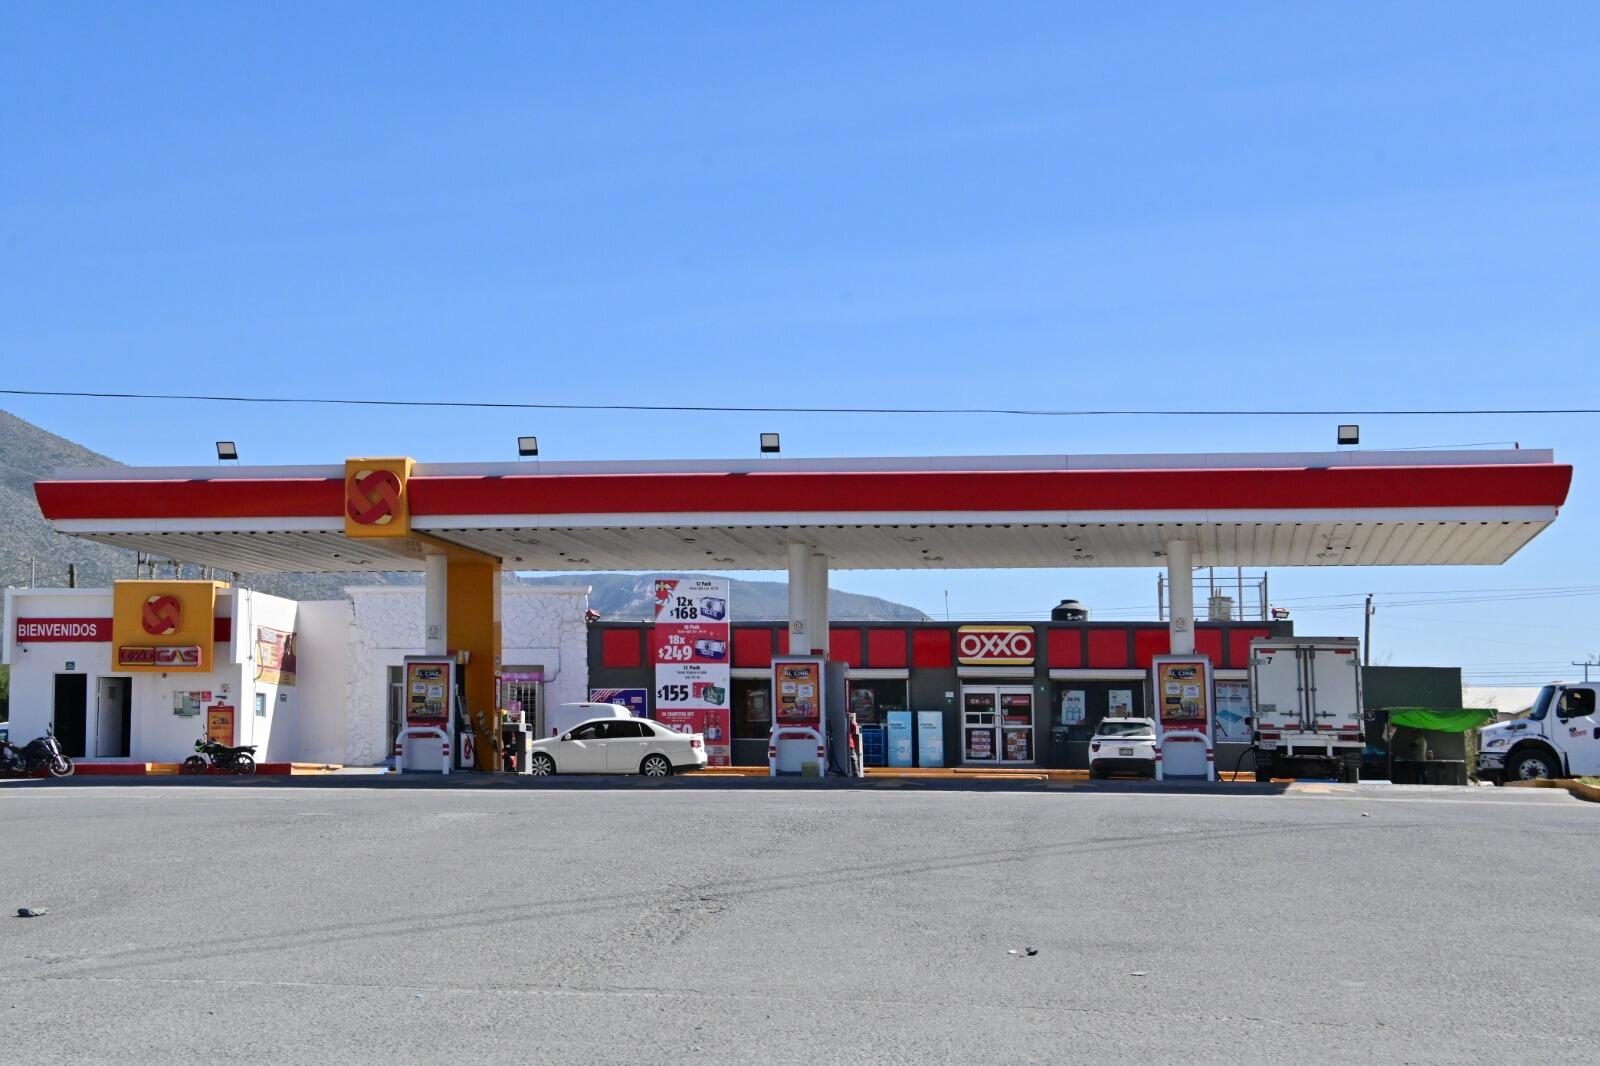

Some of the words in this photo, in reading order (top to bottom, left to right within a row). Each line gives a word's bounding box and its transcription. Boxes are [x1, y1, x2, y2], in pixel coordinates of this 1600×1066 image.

[676, 596, 694, 607] 12x
[670, 607, 698, 619] $168
[18, 623, 97, 637] BIENVENIDOS
[668, 634, 686, 645] 18x
[960, 632, 1032, 658] OXXO
[658, 645, 693, 660] $249
[1266, 656, 1273, 665] 7
[657, 684, 689, 701] $155
